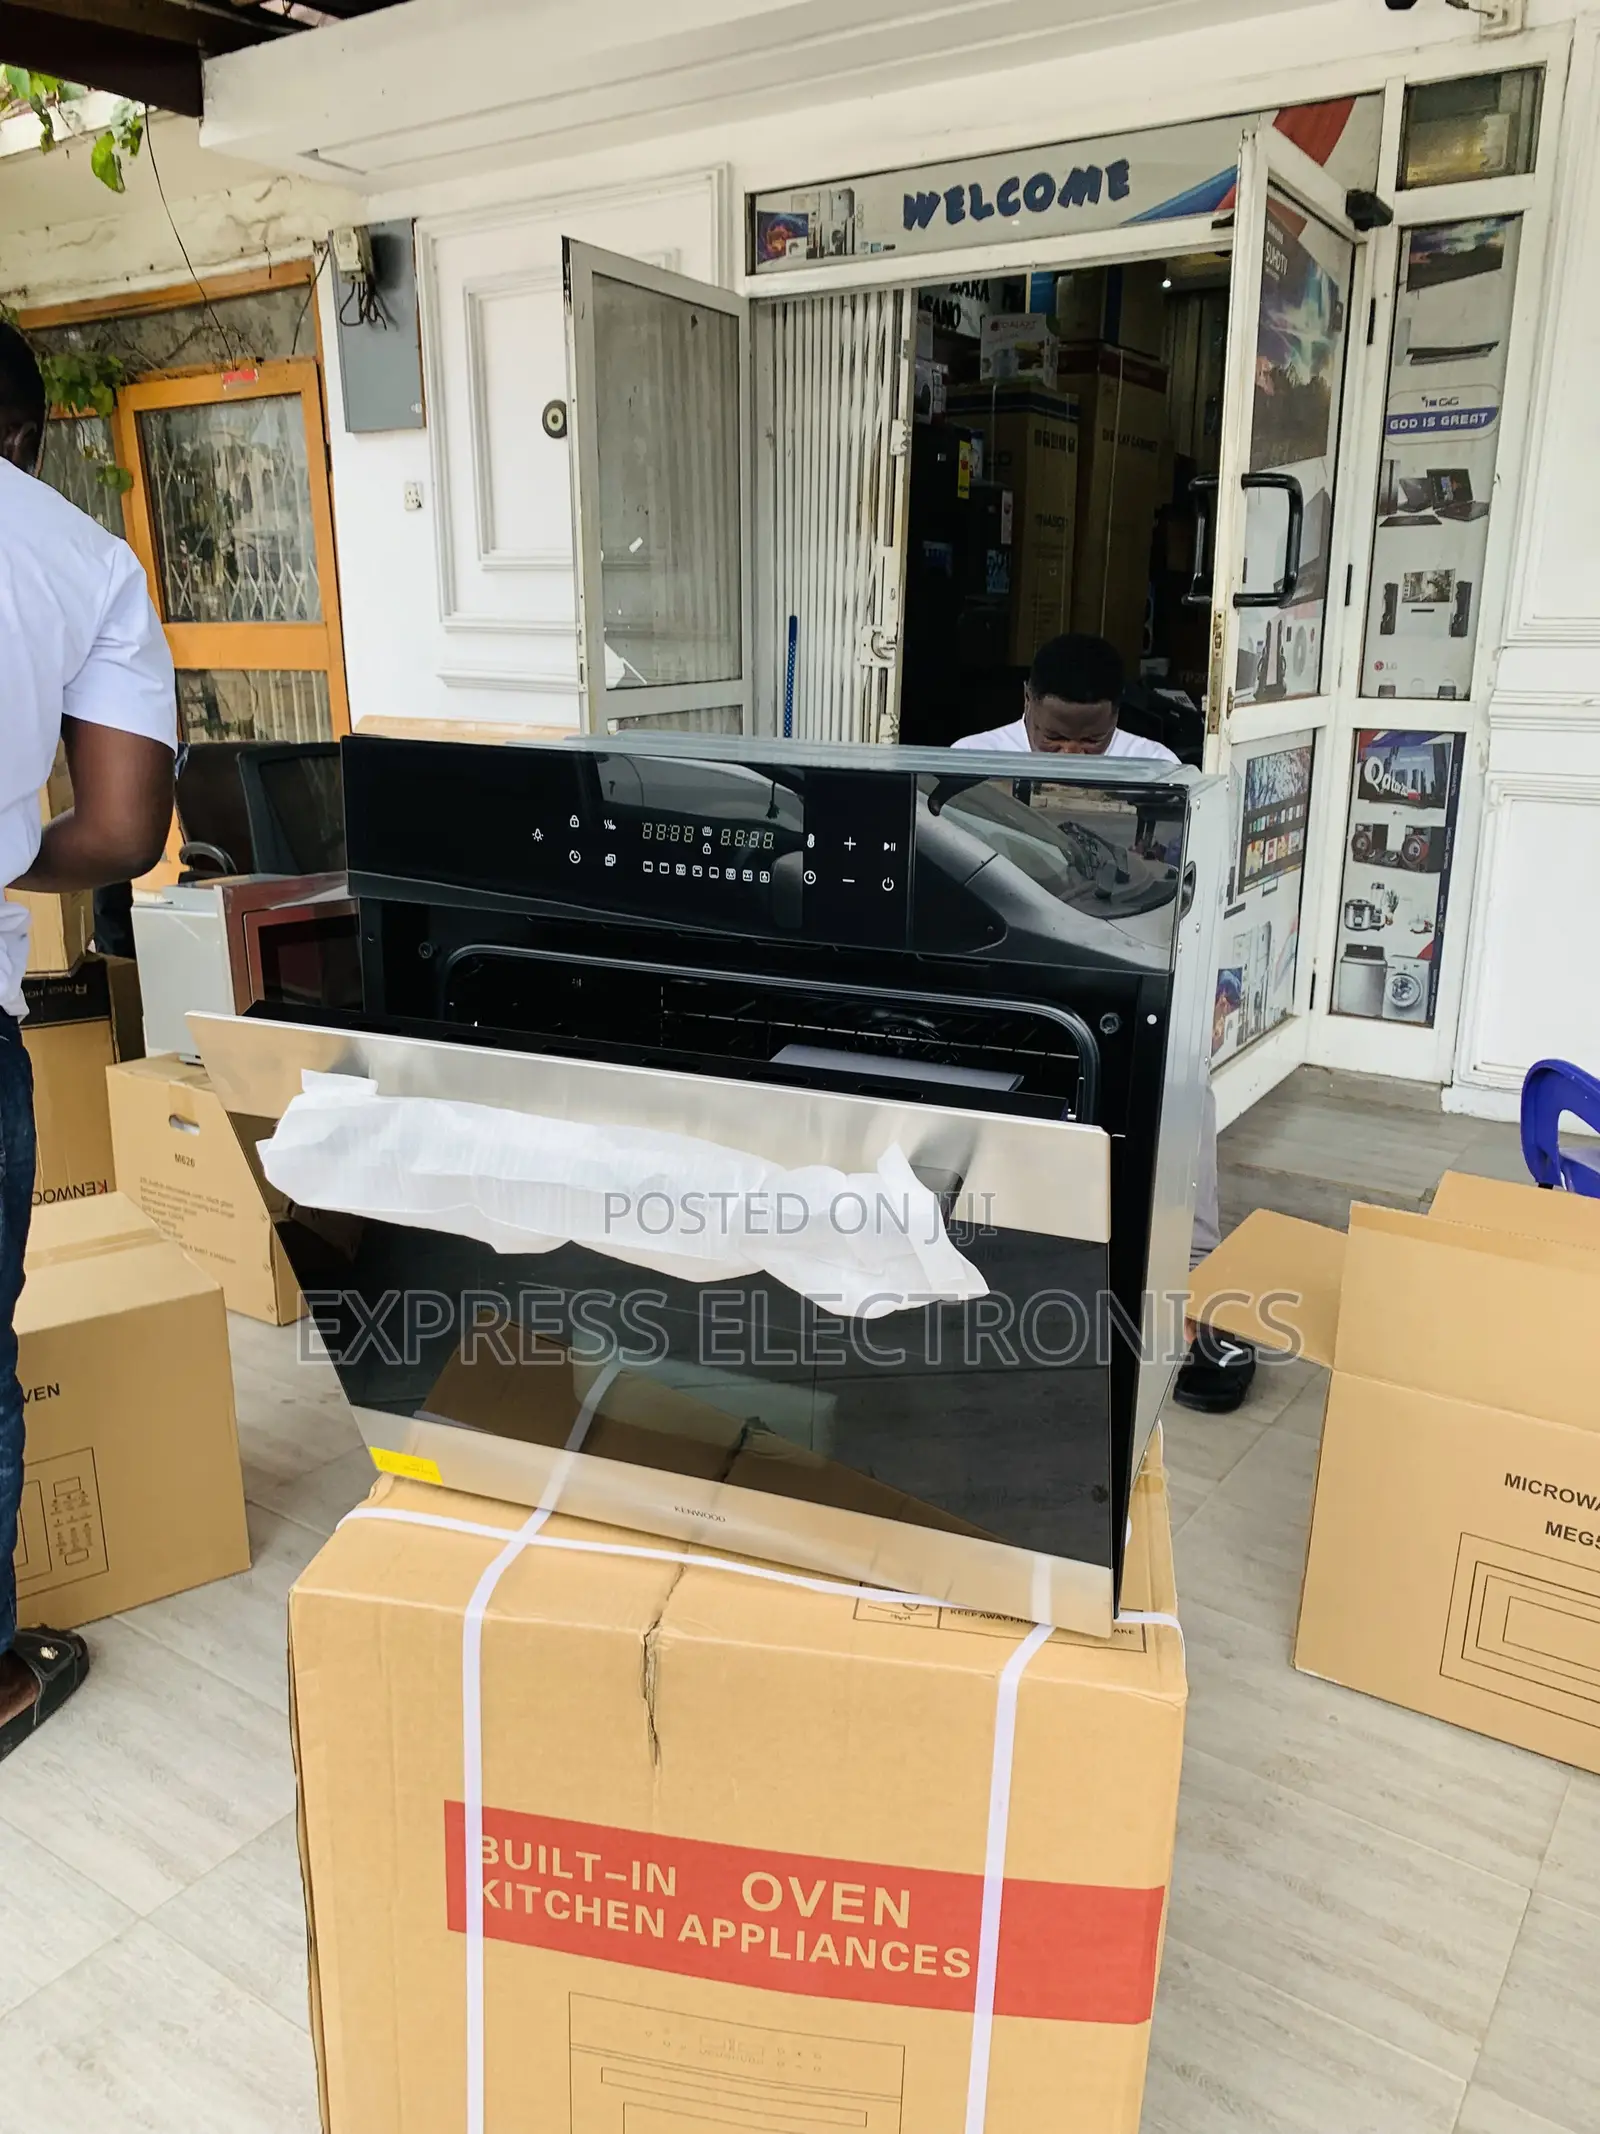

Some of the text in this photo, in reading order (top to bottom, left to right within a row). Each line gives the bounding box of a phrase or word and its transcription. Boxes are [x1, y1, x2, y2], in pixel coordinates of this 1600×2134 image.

[903, 158, 1130, 231] WELCOME
[1390, 412, 1488, 430] GOD IS GREAT
[1218, 1340, 1243, 1368] 7
[674, 1505, 726, 1523] KENWOOD
[481, 1834, 912, 1929] BUILT-IN OVEN
[482, 1878, 971, 1979] KITCHEN APPLIANCES
